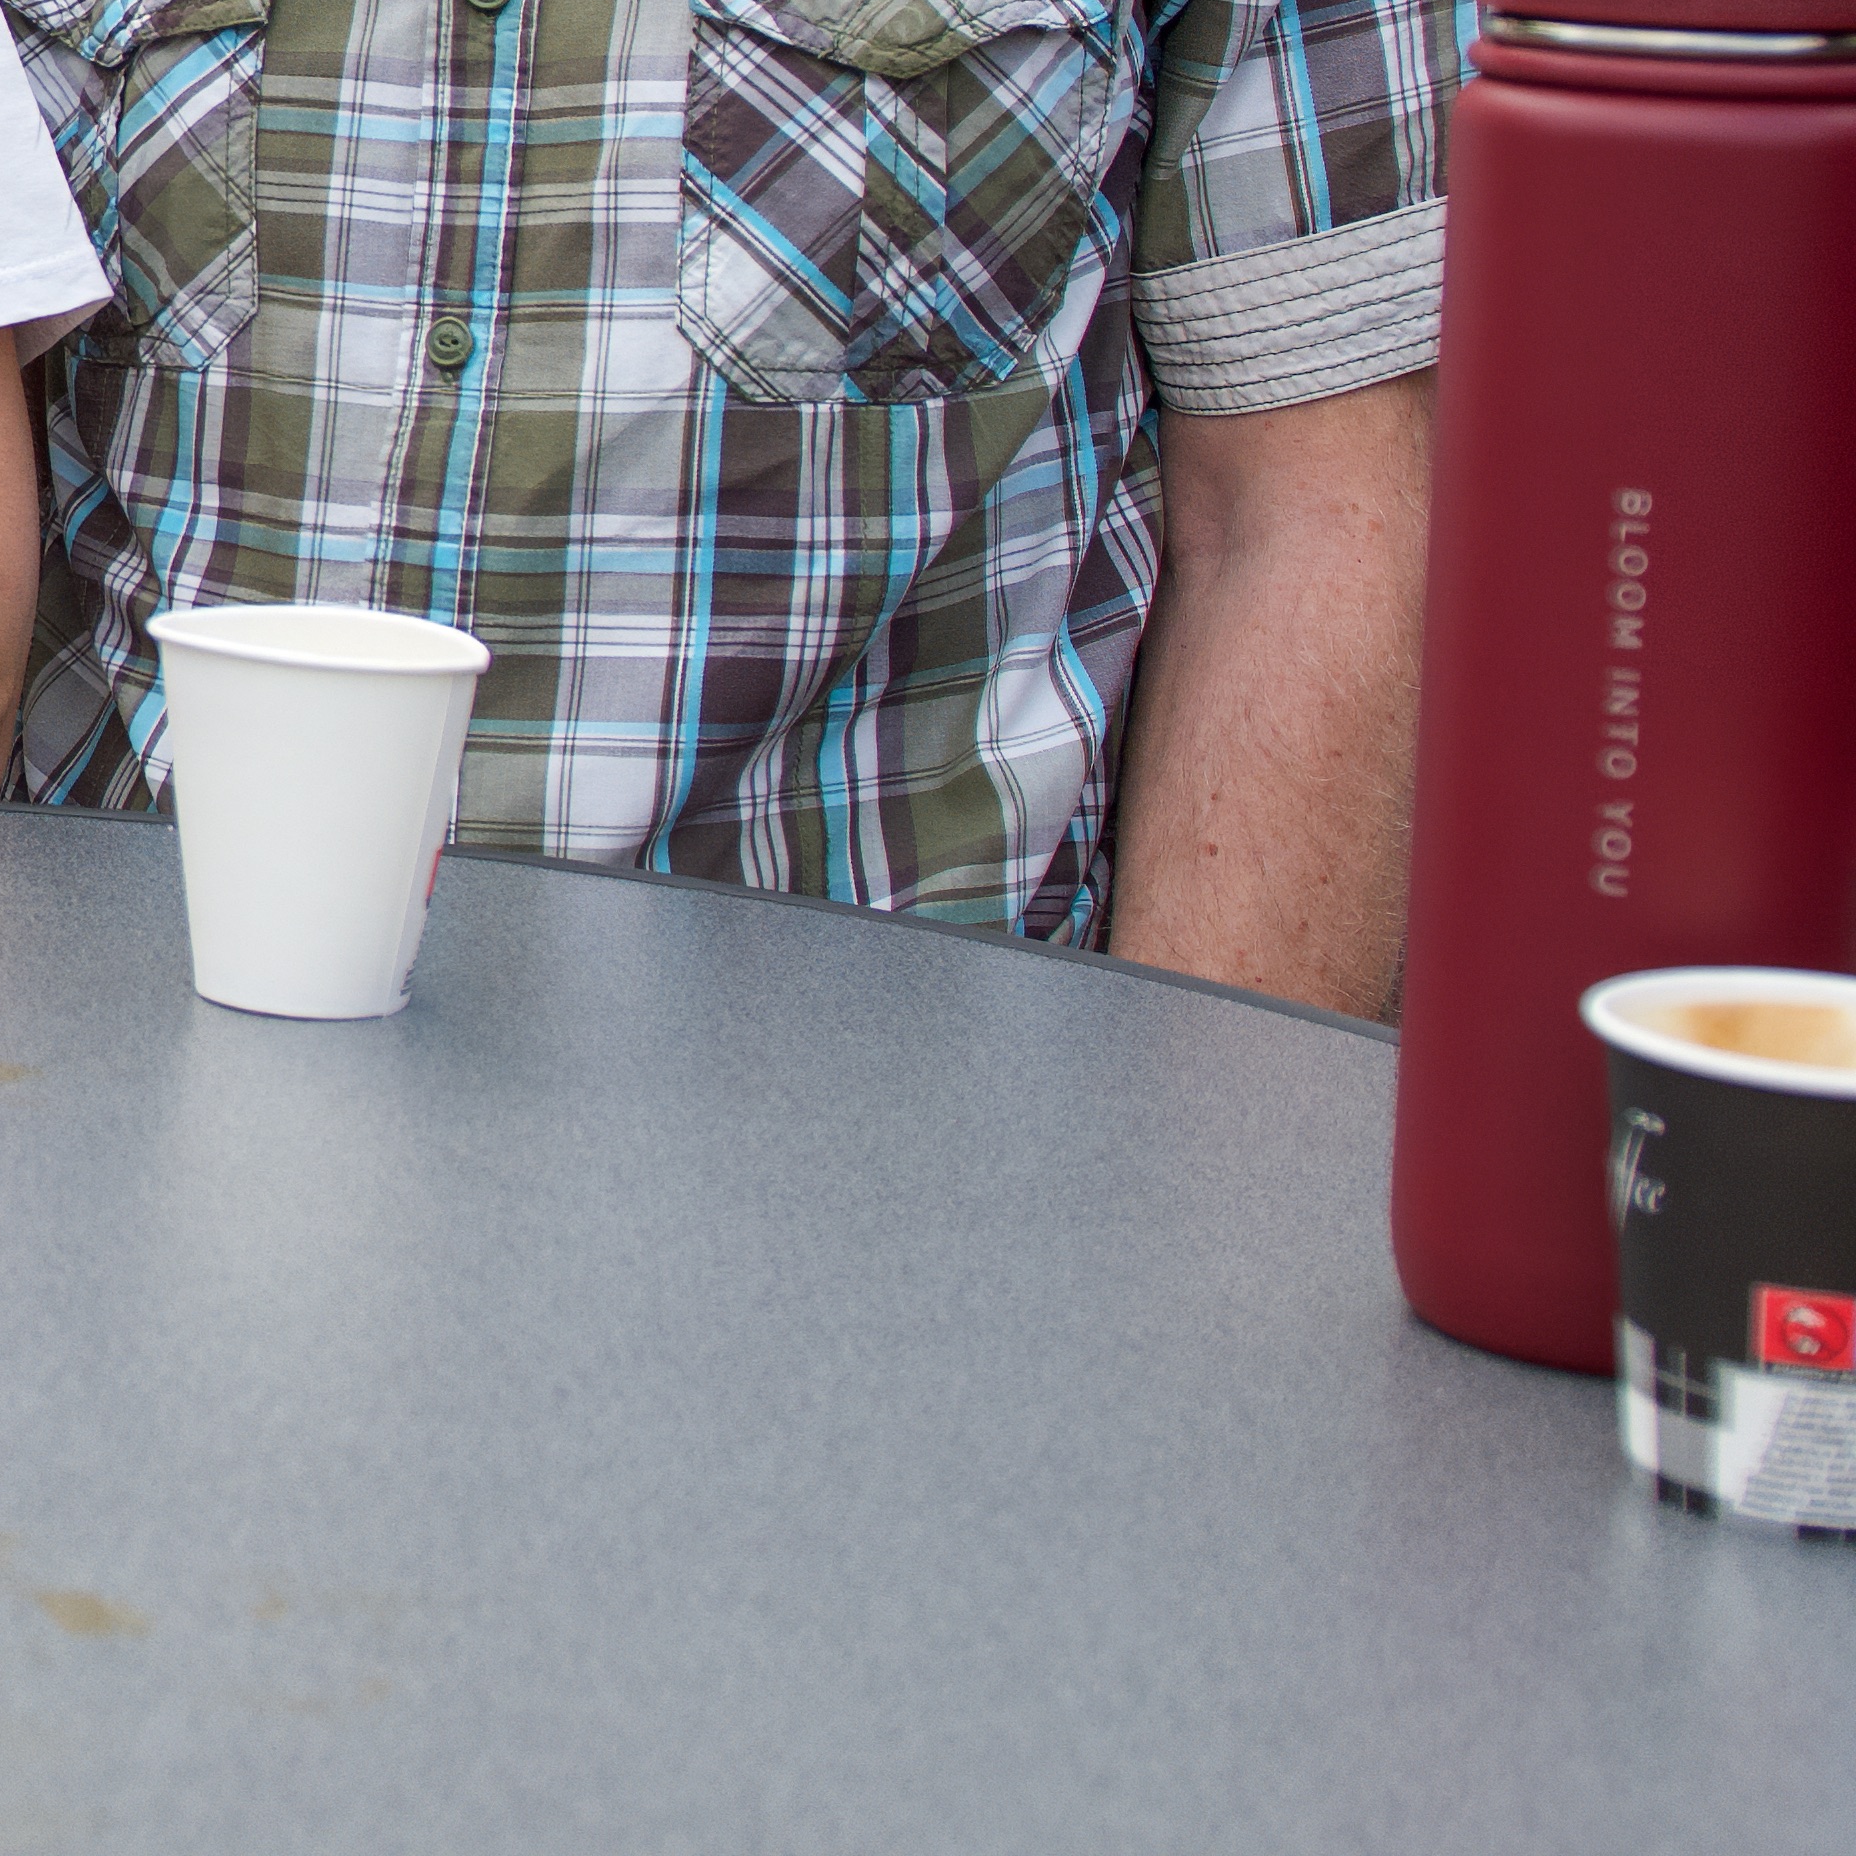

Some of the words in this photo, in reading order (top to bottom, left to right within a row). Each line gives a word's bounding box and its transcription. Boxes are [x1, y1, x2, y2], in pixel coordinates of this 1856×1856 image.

[1607, 487, 1654, 650] BLOOM
[1600, 667, 1642, 780] INTO
[1592, 800, 1635, 898] YOU
